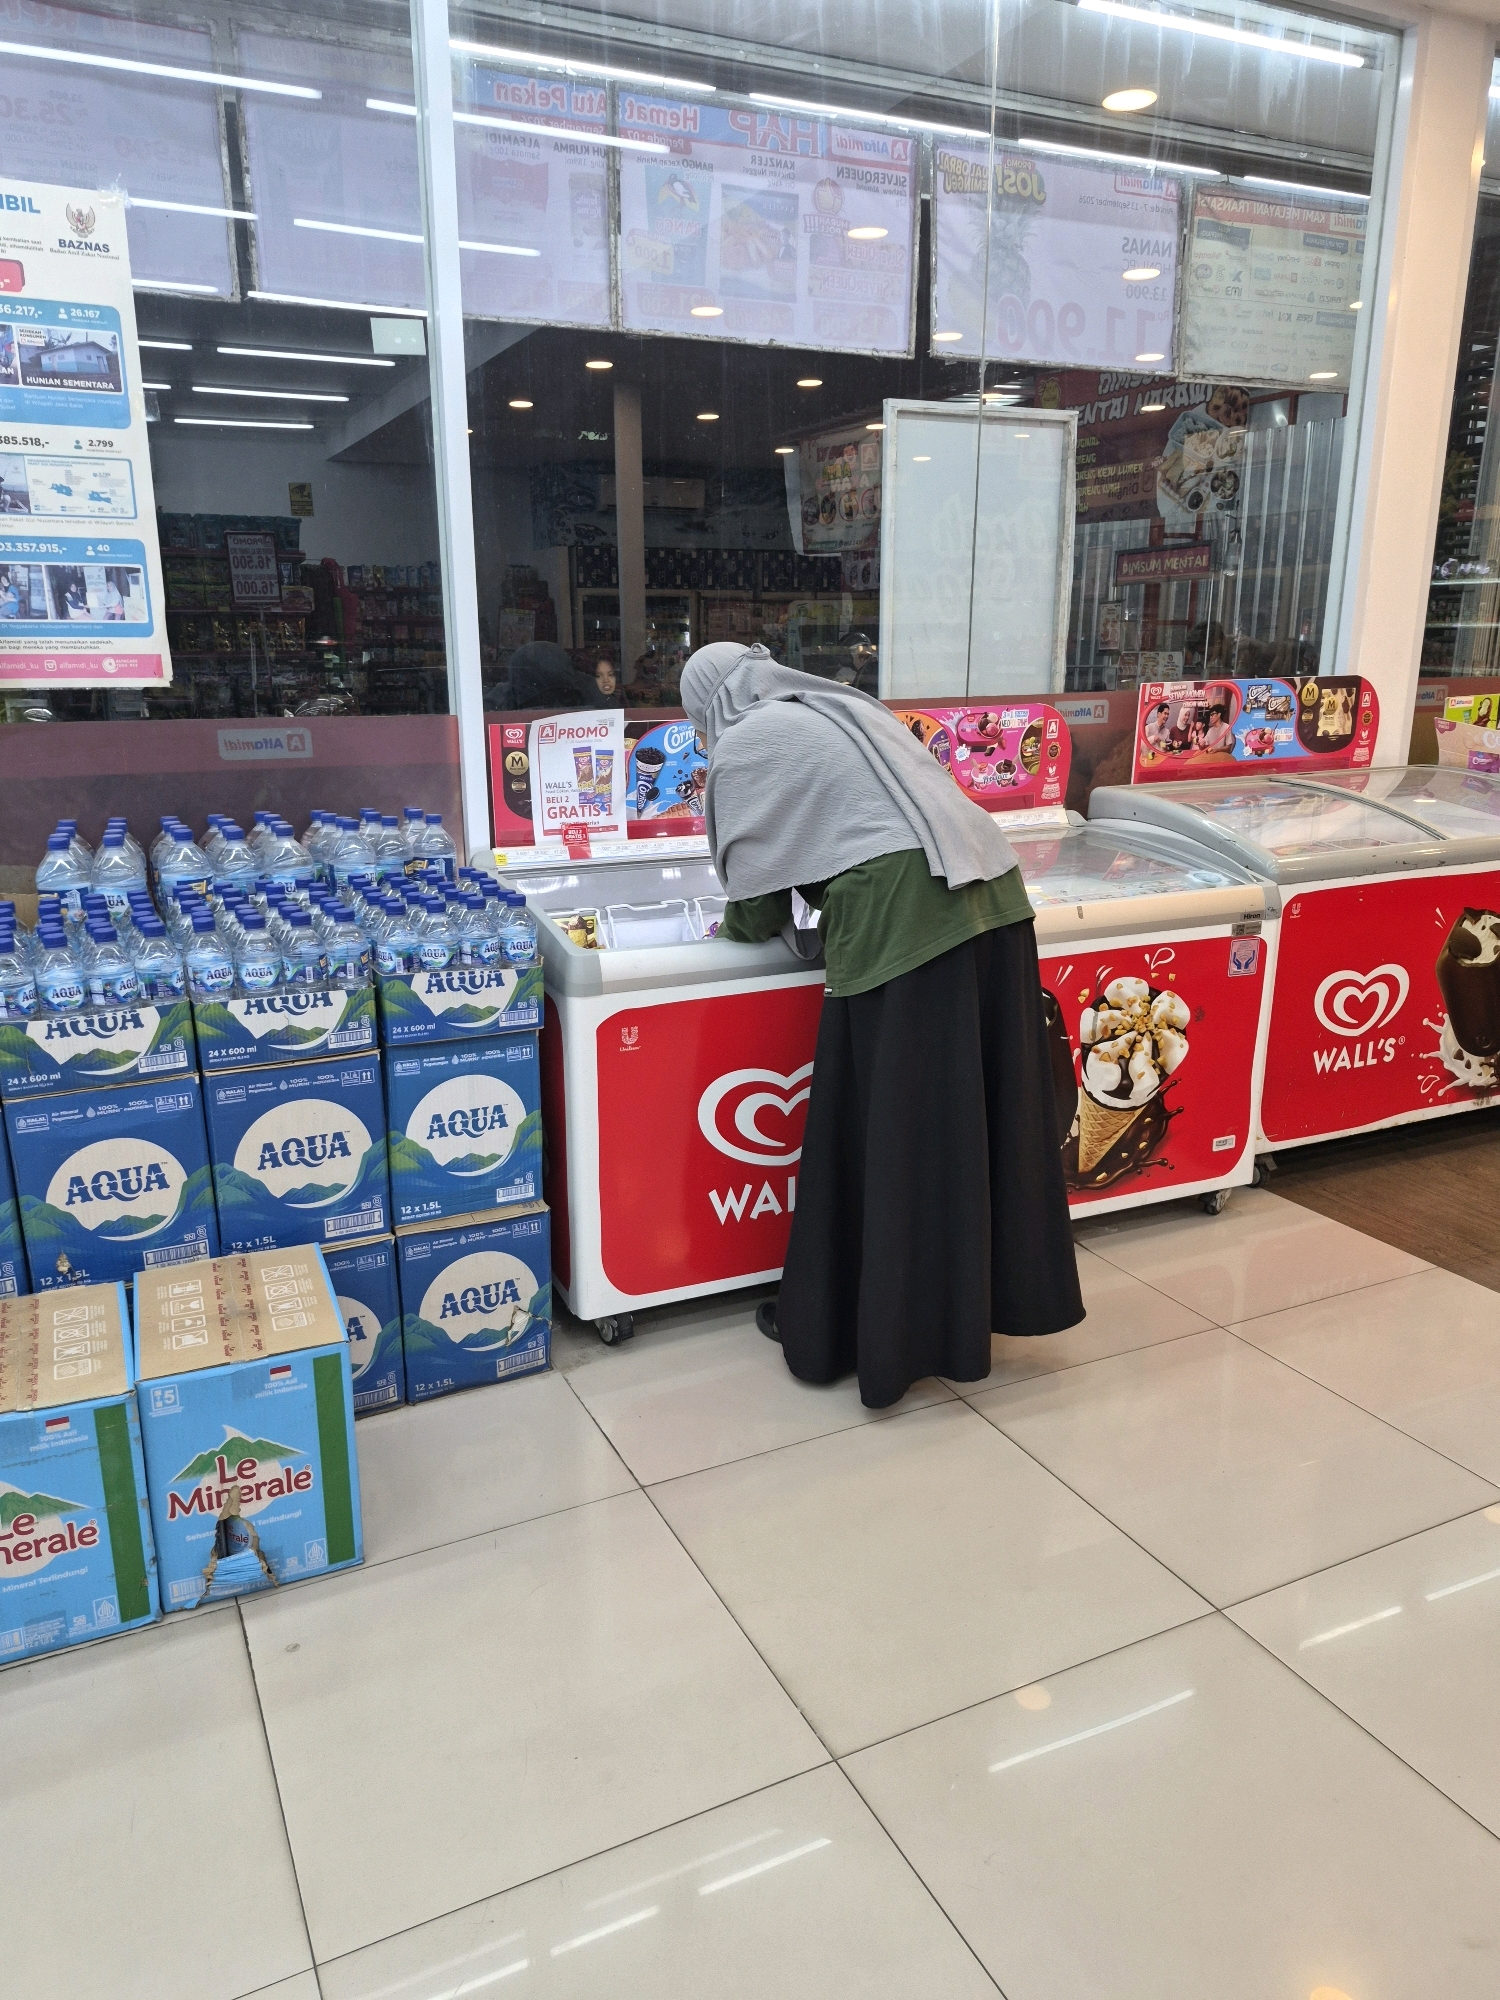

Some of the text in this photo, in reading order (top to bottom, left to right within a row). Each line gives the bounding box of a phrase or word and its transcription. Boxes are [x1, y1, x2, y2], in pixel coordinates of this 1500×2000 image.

[58, 238, 110, 253] BAZNAS
[70, 308, 100, 319] 26.167
[26, 376, 114, 390] HUNIAN SEMENTARA
[88, 439, 113, 448] 2.799
[1097, 462, 1144, 478] KEJU LUMER
[97, 544, 110, 552] 40
[1122, 554, 1208, 575] DIMSUM MENTAI
[59, 662, 98, 670] alfamidi_ku
[1186, 690, 1206, 699] MOMEN
[1305, 687, 1315, 698] M
[558, 725, 609, 739] PROMO
[511, 756, 523, 767] M
[545, 781, 572, 789] WALL'S
[547, 804, 613, 819] GRATIS 1
[422, 947, 446, 959] AQUA
[510, 941, 533, 952] AQUA
[207, 967, 232, 981] AQUA
[244, 966, 274, 979] AQUA
[52, 985, 82, 1000] AQUA
[411, 1024, 425, 1032] 600
[208, 1045, 257, 1058] 24 600 ml
[1313, 1037, 1397, 1075] WALL'S
[7, 1072, 61, 1086] 24 600 ml
[51, 1114, 84, 1122] Pegunungan
[427, 1104, 509, 1140] AQUA
[257, 1131, 351, 1171] AQUA
[65, 1162, 170, 1206] AQUA
[401, 1201, 441, 1214] 12 1.5L
[231, 1235, 276, 1249] 12 1.5L
[40, 1277, 53, 1286] 12
[439, 1279, 521, 1319] AQUA
[255, 1383, 308, 1398] milik Indonesia
[264, 1377, 298, 1390] 100% Asli
[415, 1378, 454, 1391] 12 1.5L
[164, 1389, 174, 1403] 5
[38, 1428, 78, 1442] 100% Asli
[29, 1434, 89, 1452] milik Indonesia
[216, 1455, 257, 1484] Le
[257, 1510, 302, 1526] Terlindungi
[2, 1566, 88, 1593] Mineral Terlindungi
